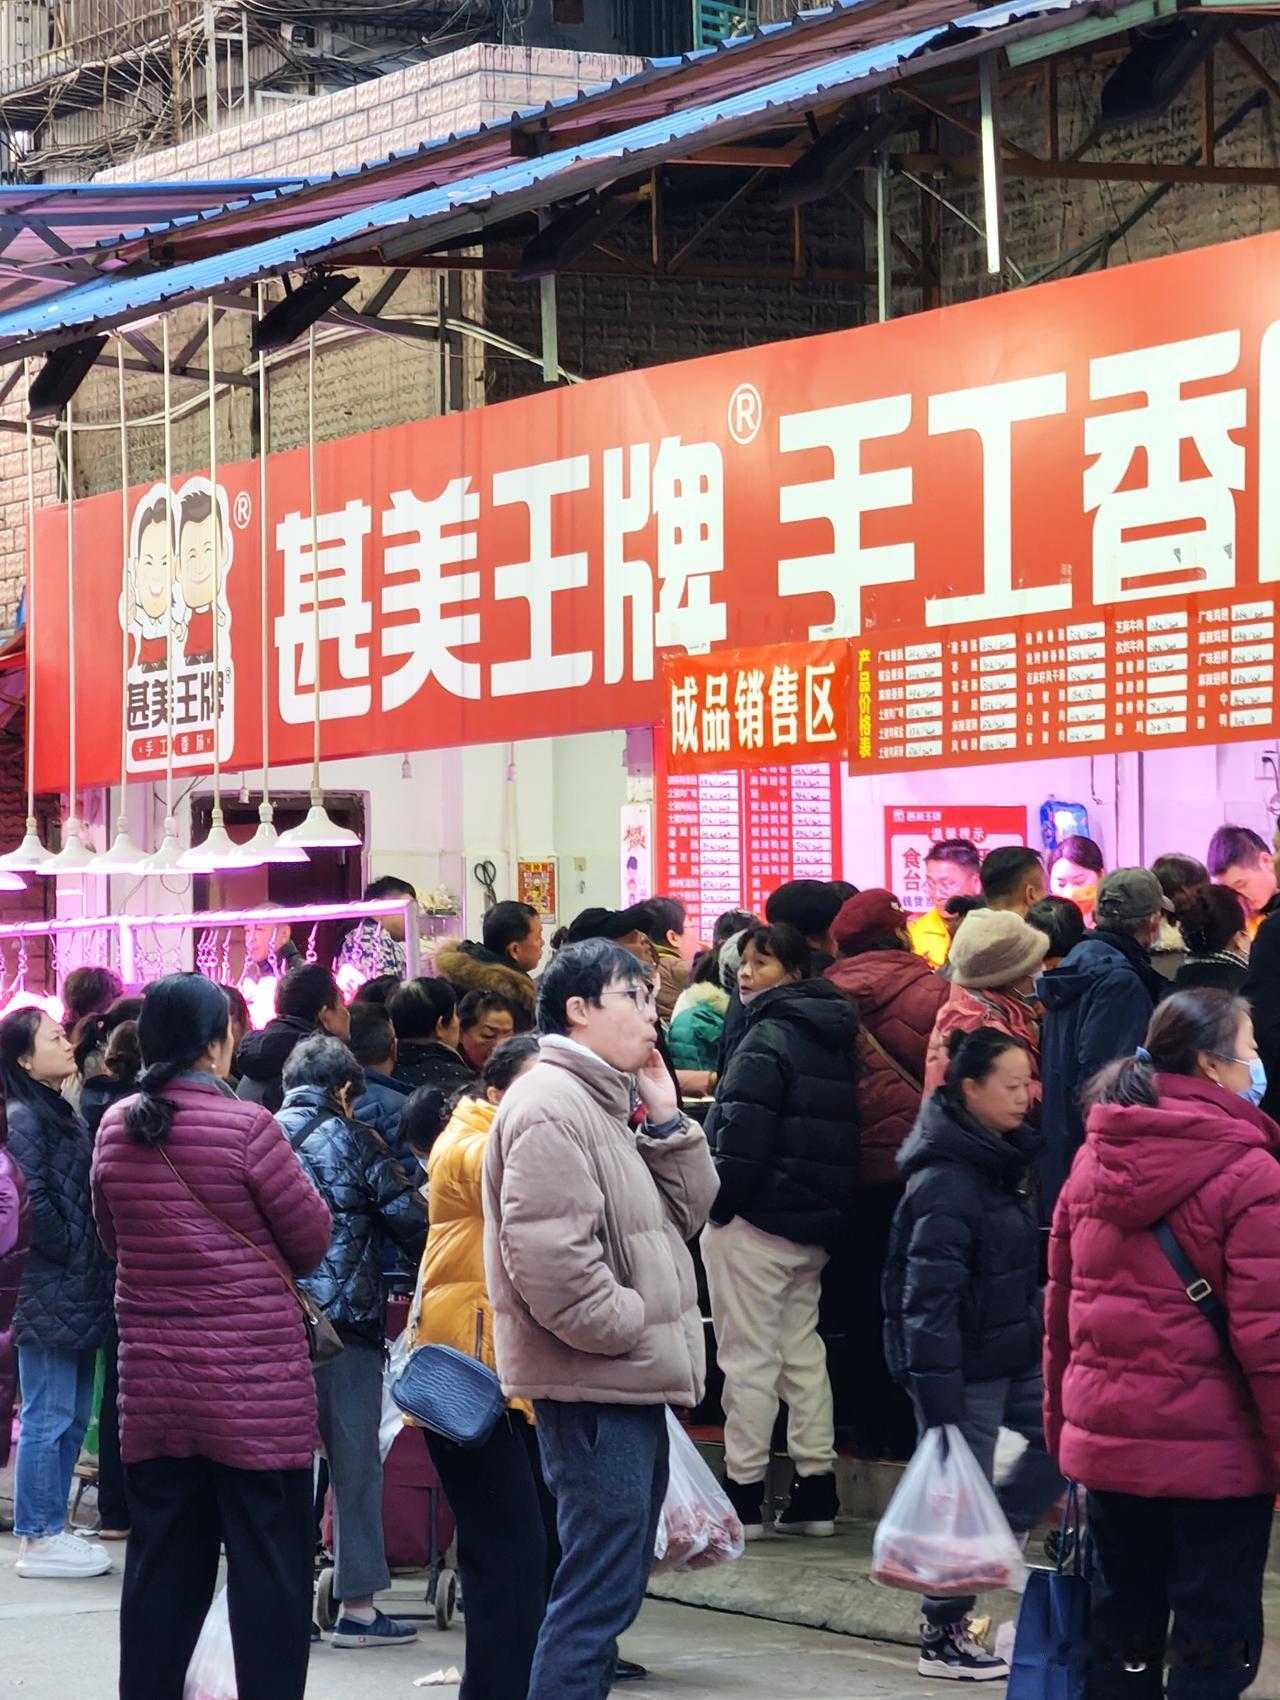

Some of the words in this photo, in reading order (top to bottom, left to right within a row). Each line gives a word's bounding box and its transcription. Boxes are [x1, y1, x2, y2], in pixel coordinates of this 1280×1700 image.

[275, 436, 727, 724] 甚美王牌
[778, 320, 1280, 640] 手工香
[671, 661, 837, 755] 成品销售区
[858, 649, 872, 758] 产品价格表
